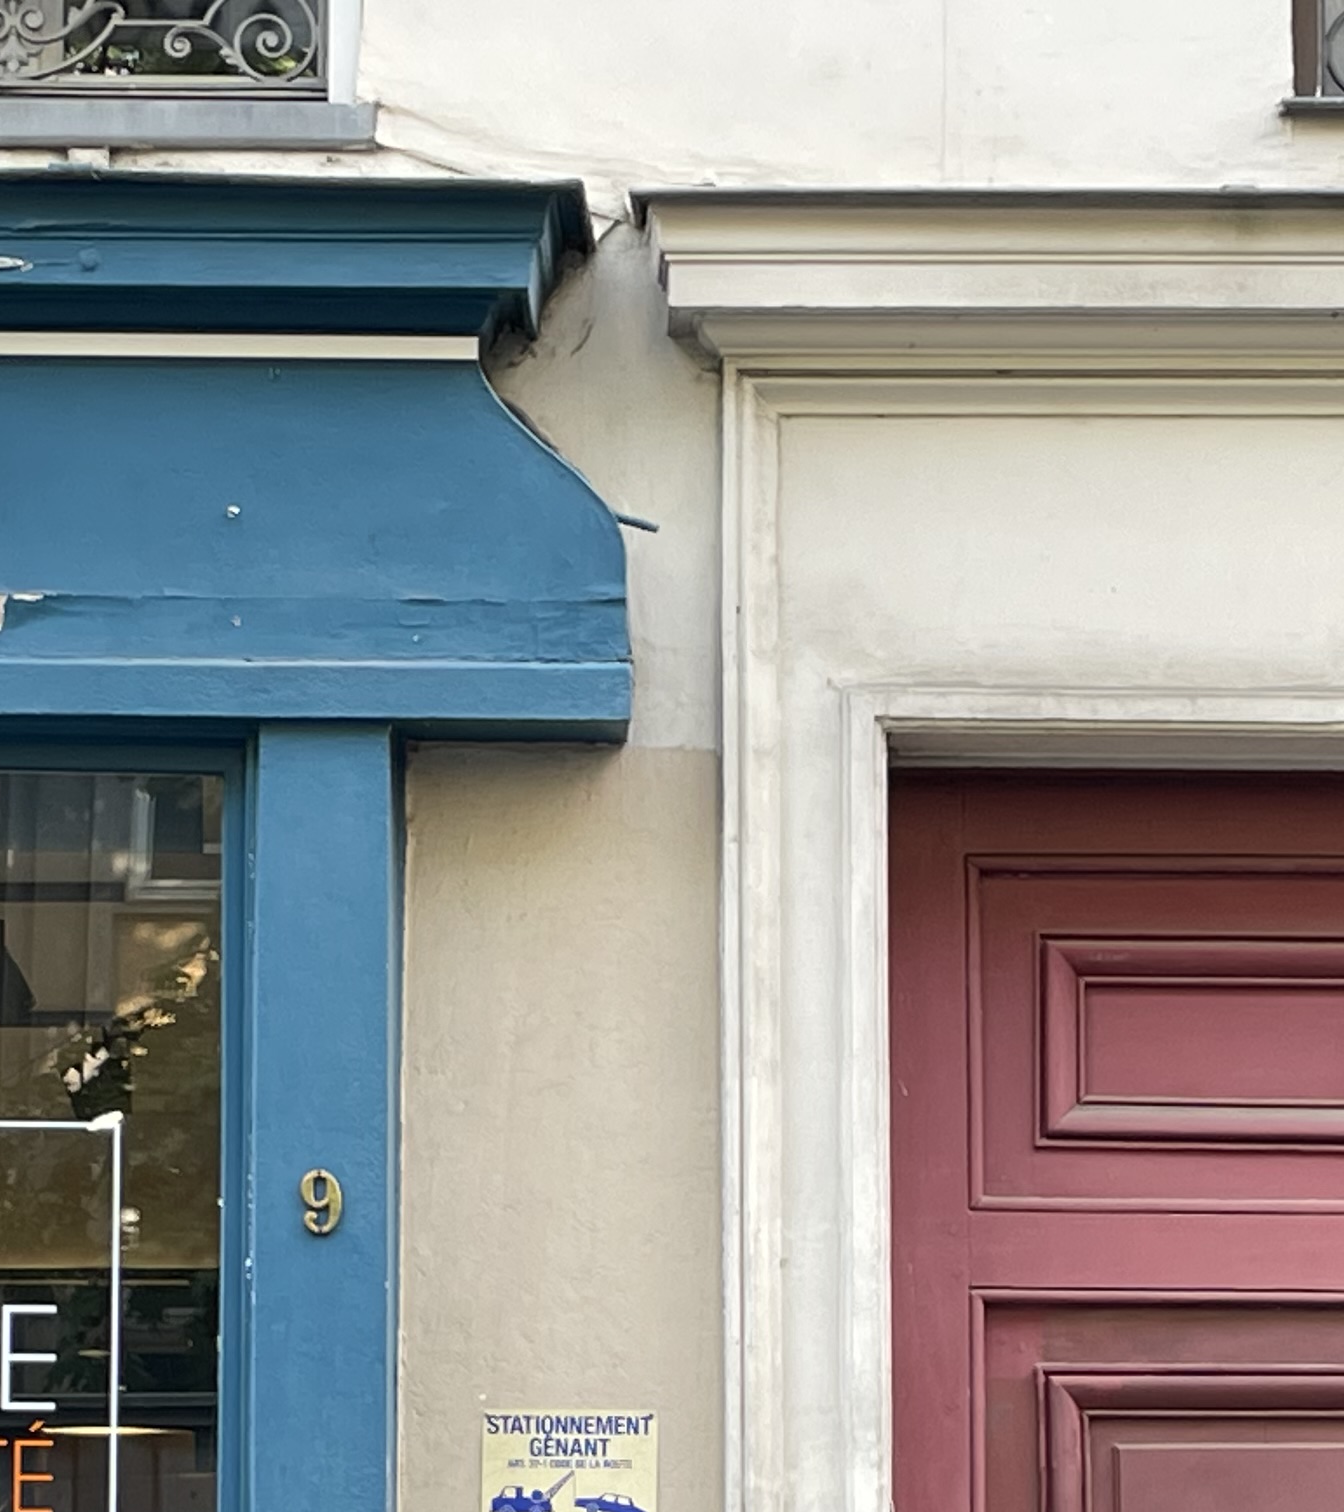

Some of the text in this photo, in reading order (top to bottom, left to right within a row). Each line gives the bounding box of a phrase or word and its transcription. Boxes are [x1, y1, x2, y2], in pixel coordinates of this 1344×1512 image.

[299, 1167, 343, 1236] 9
[486, 1414, 652, 1435] STATIONNEMENT
[529, 1434, 611, 1457] GÊNANT
